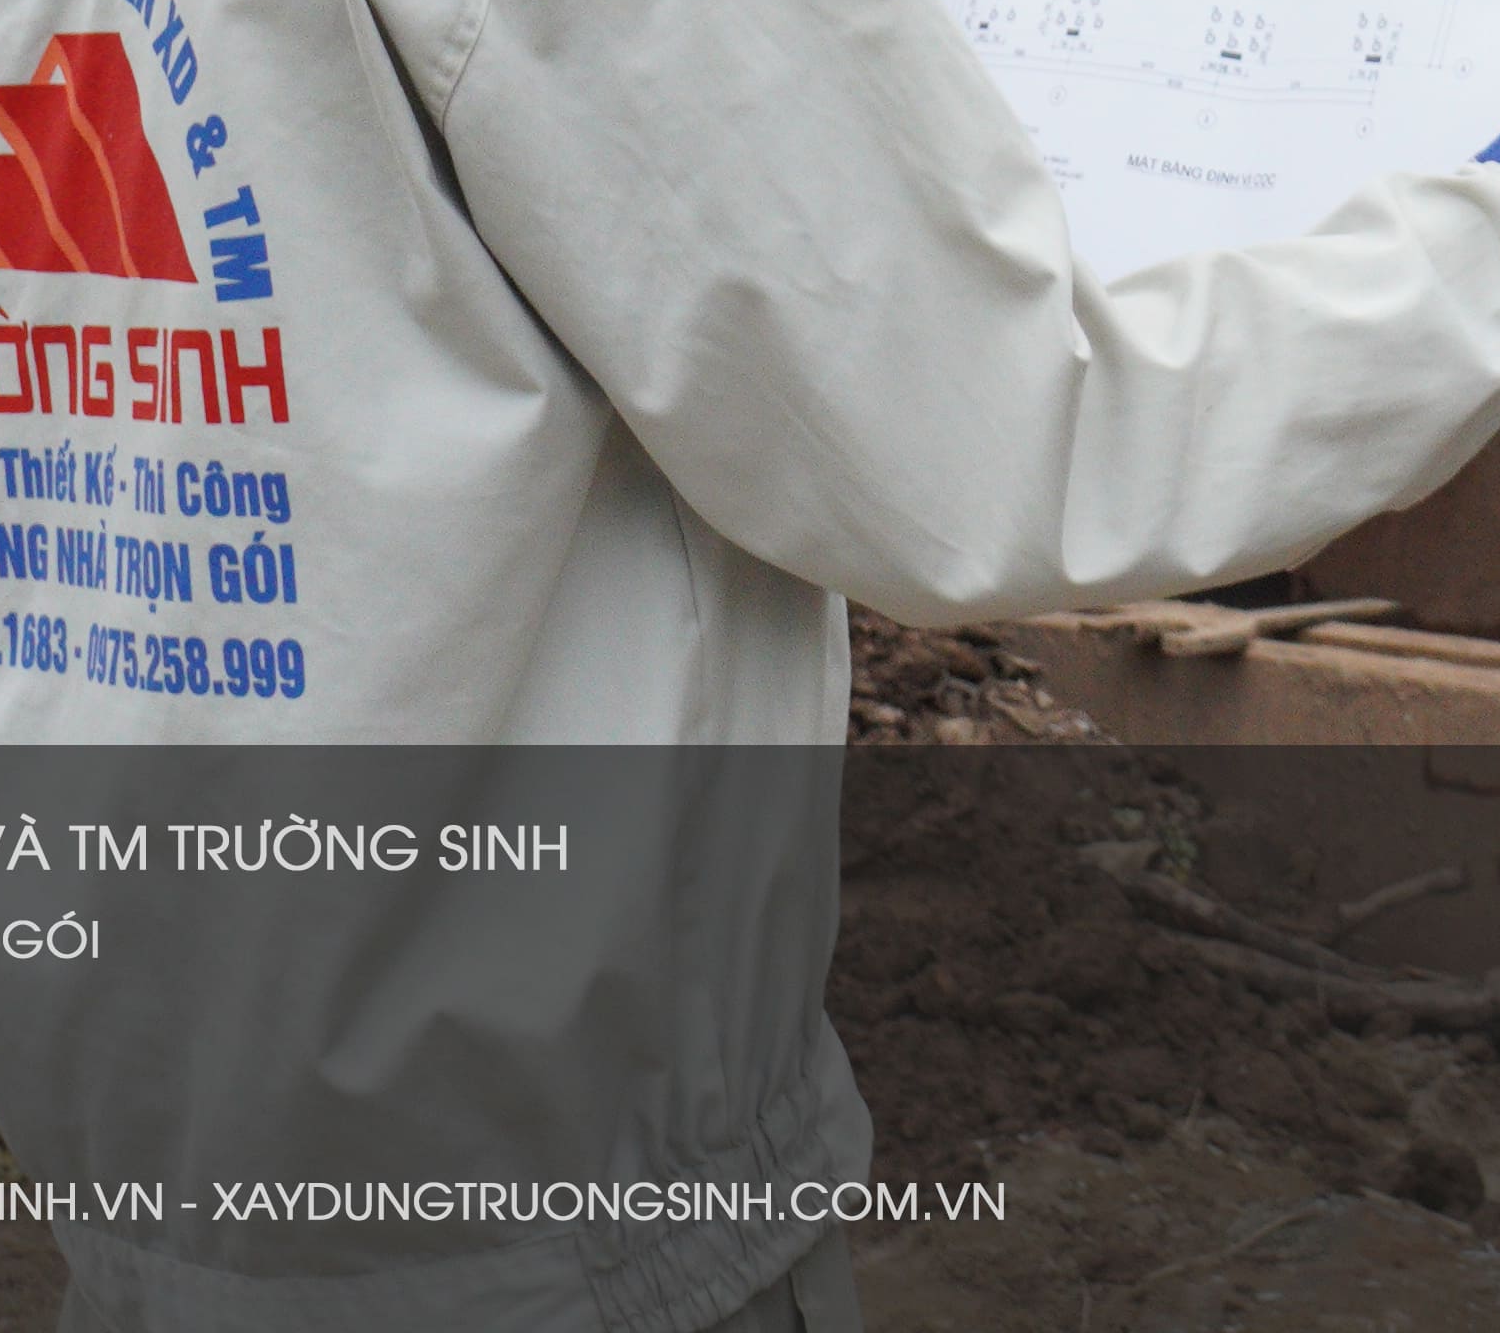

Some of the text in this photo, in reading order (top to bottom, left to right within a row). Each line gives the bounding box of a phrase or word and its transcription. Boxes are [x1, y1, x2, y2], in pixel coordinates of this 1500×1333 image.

[186, 113, 228, 181] &
[203, 185, 274, 303] TM
[85, 443, 115, 507] Kế
[134, 456, 166, 516] Thi
[176, 460, 292, 525] Công
[56, 520, 107, 589] NHÀ
[115, 535, 193, 614] TRỌN
[208, 531, 297, 605] GÓI
[86, 622, 306, 700] 0975.258.999
